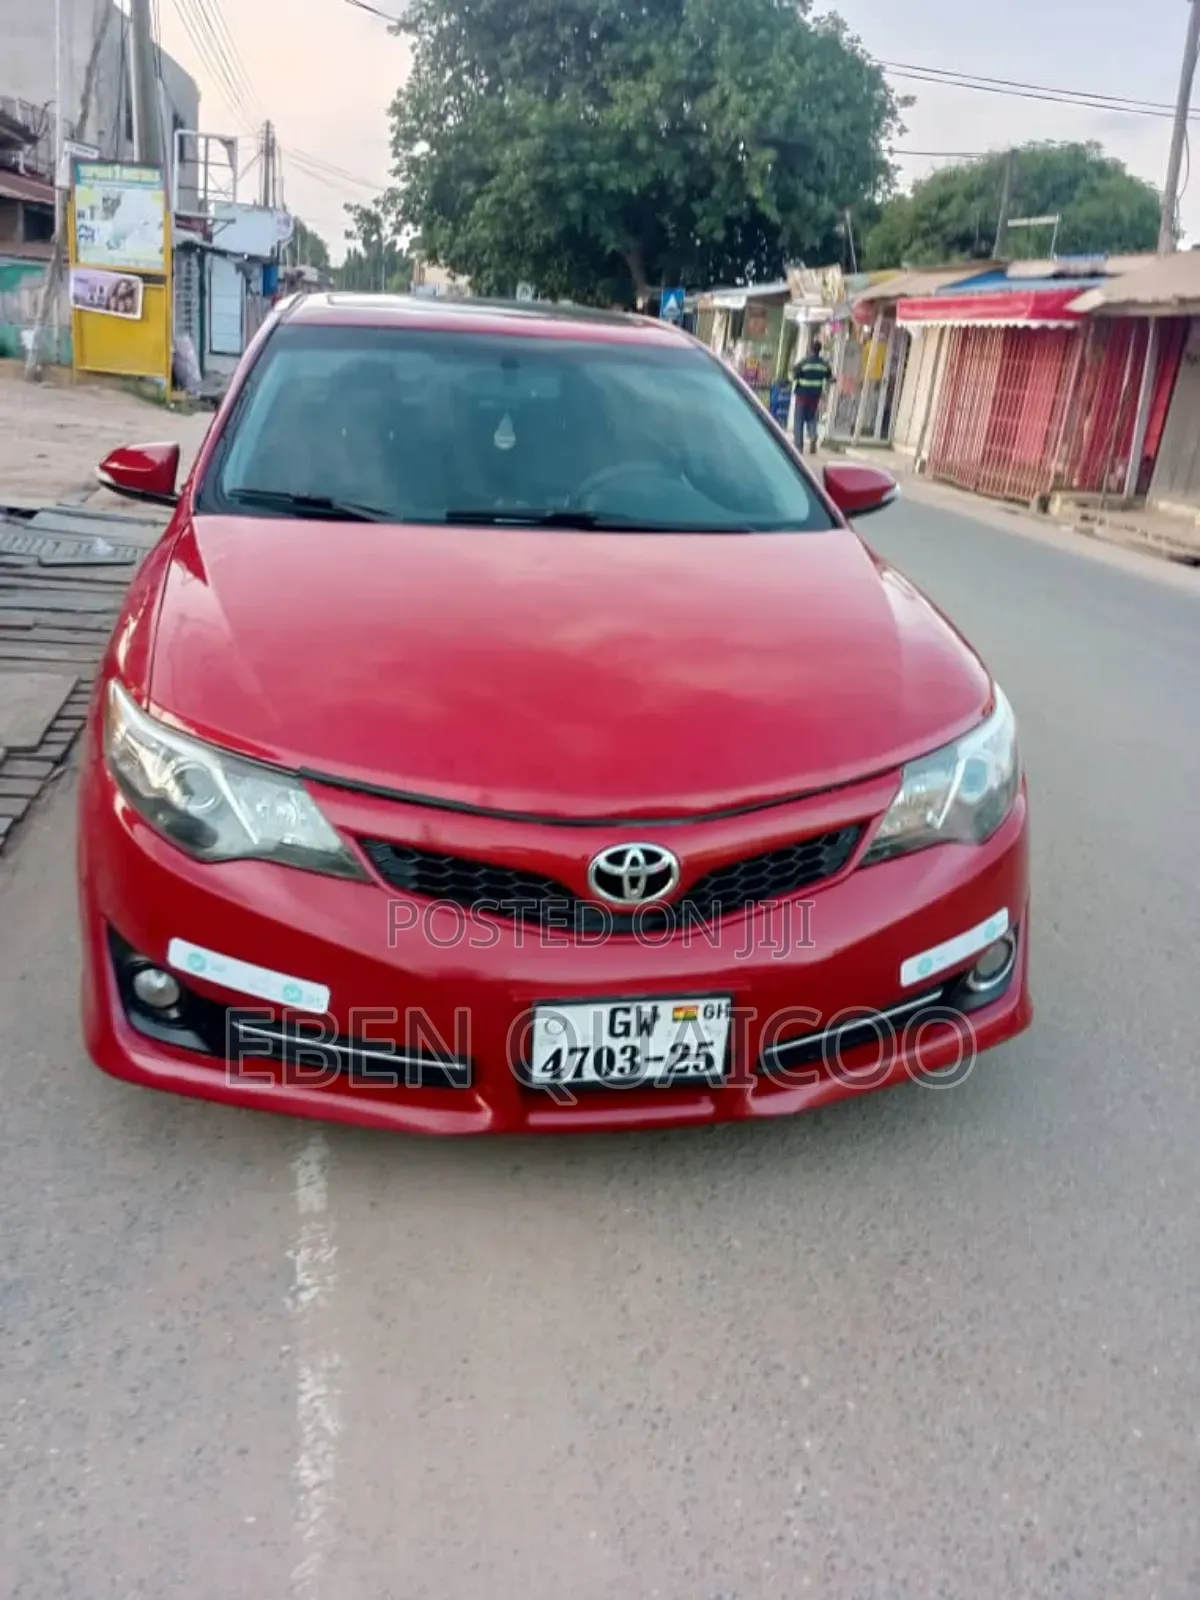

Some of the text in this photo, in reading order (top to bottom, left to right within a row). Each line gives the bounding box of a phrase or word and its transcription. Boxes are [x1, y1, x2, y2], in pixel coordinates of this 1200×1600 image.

[608, 1005, 660, 1038] GW
[703, 1003, 730, 1020] GH
[541, 1041, 715, 1080] 4703-25
